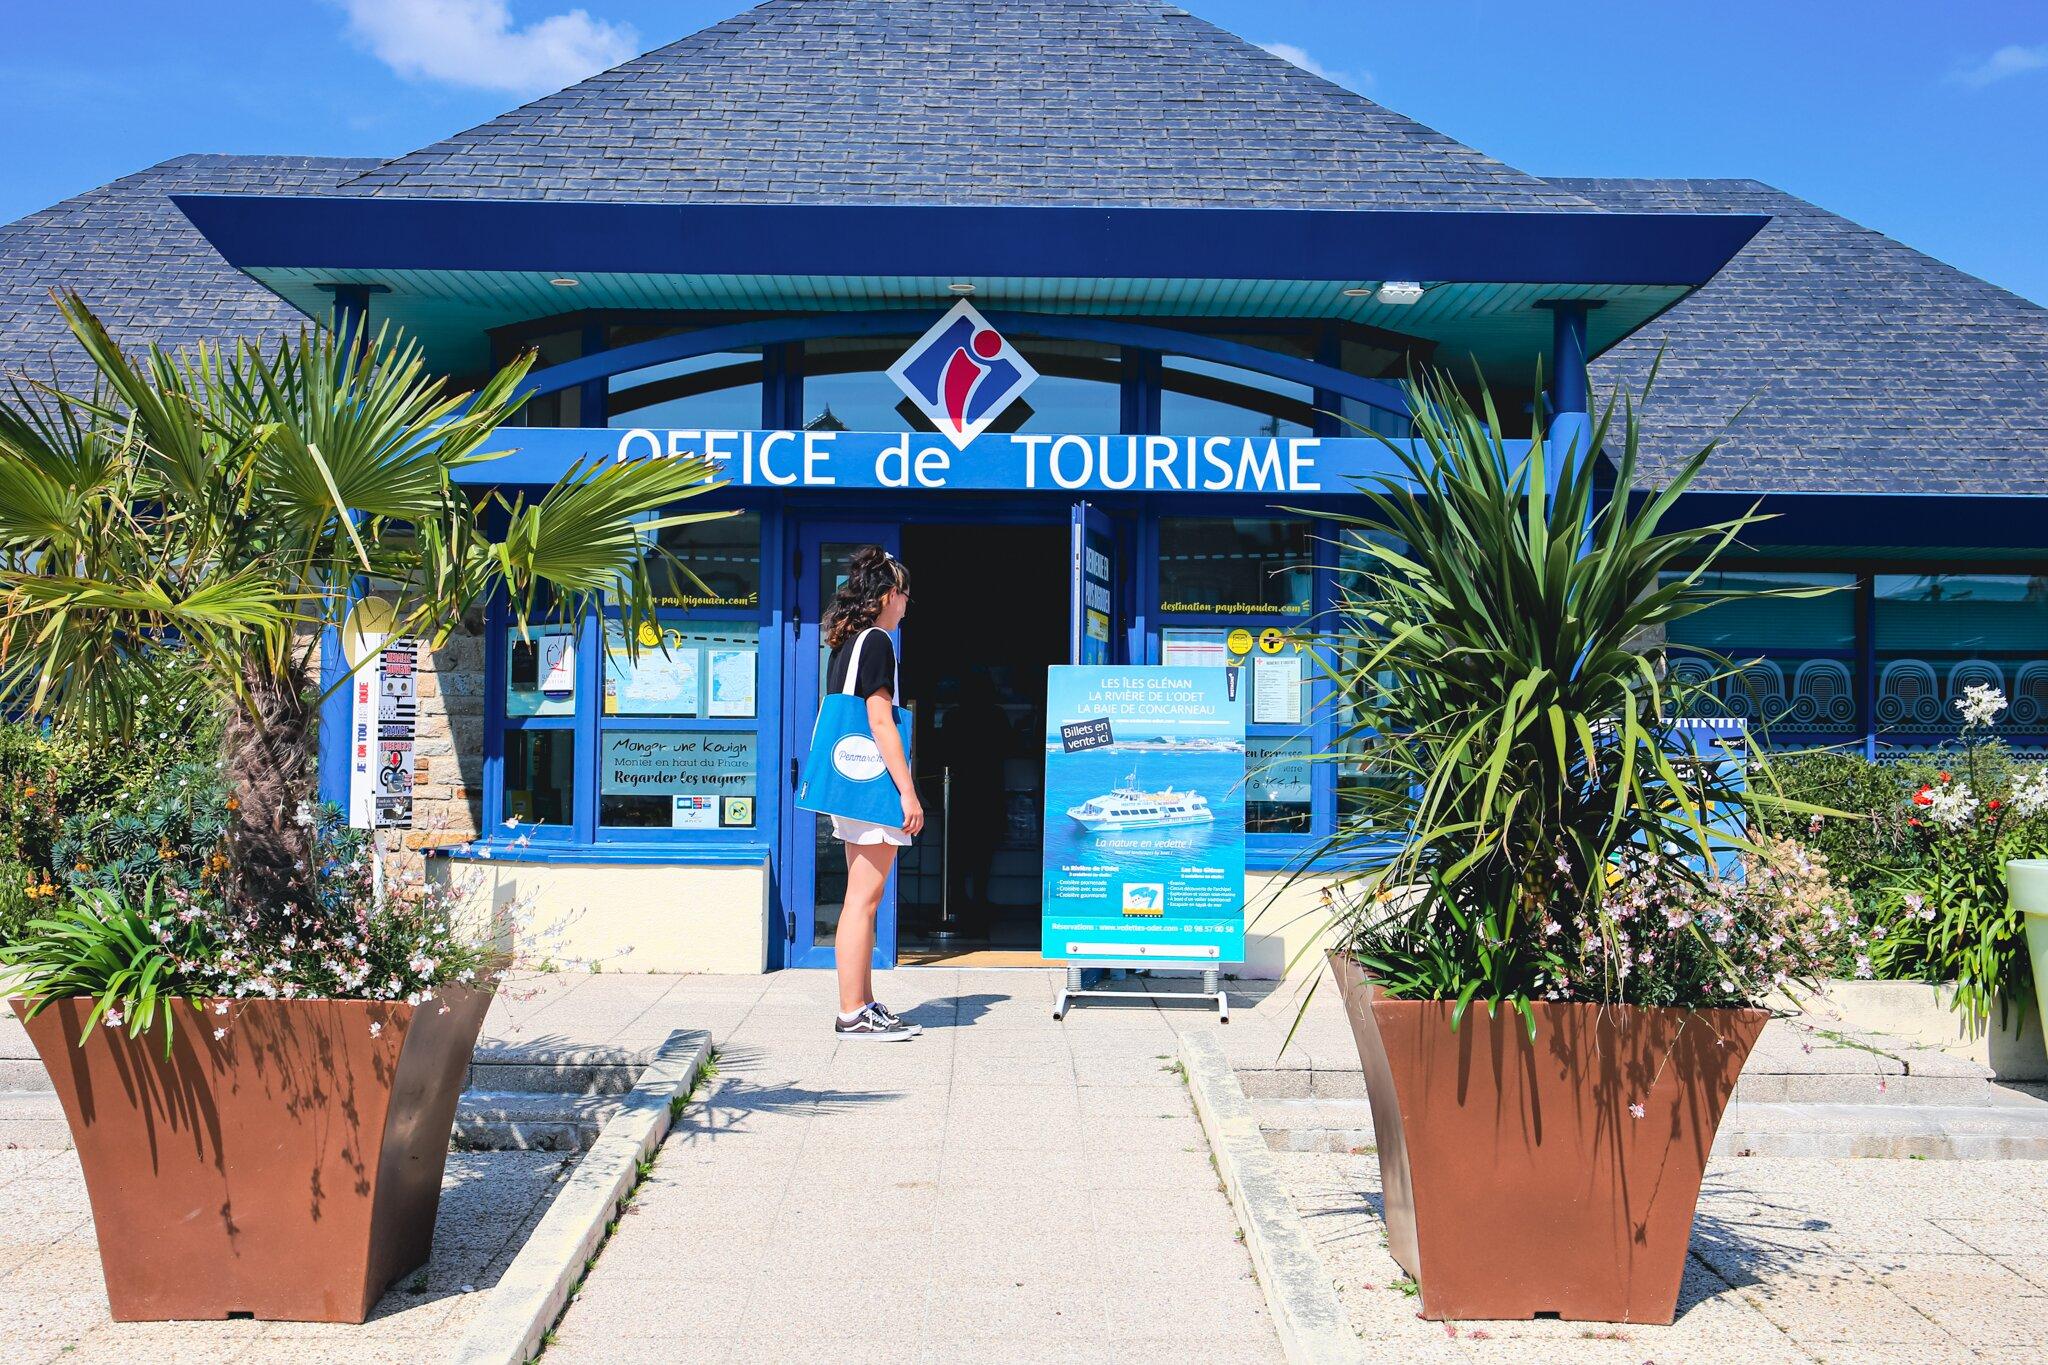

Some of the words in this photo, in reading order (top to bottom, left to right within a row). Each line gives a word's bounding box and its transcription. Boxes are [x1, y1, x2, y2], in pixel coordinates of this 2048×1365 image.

[874, 432, 951, 488] de
[1010, 434, 1321, 490] TOURISME
[1160, 601, 1301, 615] destination-paysbigouden.com
[1101, 678, 1120, 689] LES
[1123, 676, 1145, 689] ÎLES
[1147, 676, 1192, 689] GLÉNAN
[1088, 691, 1102, 701] LA
[1104, 689, 1145, 701] RIVIÈRE
[1148, 691, 1163, 702] DE
[1166, 691, 1205, 702] L'ODET
[1077, 704, 1091, 714] LA
[1093, 704, 1117, 714] BAIE
[1120, 704, 1136, 714] DE
[1138, 704, 1216, 715] CONCARNEAU
[1063, 723, 1094, 739] Billets
[1095, 722, 1108, 733] en
[613, 737, 667, 757] Manger
[673, 742, 697, 752] une
[1067, 738, 1096, 750] vente
[1097, 733, 1110, 745] ici
[614, 758, 652, 768] Monter
[655, 760, 669, 768] en
[672, 758, 698, 768] haut
[700, 758, 715, 768] du
[717, 758, 749, 769] Phare
[614, 770, 677, 788] Regarder
[680, 770, 699, 784] les
[701, 774, 747, 788] vagues
[1095, 838, 1107, 848] La
[1108, 839, 1139, 848] nature
[1140, 840, 1153, 848] en
[1154, 838, 1187, 848] vedette
